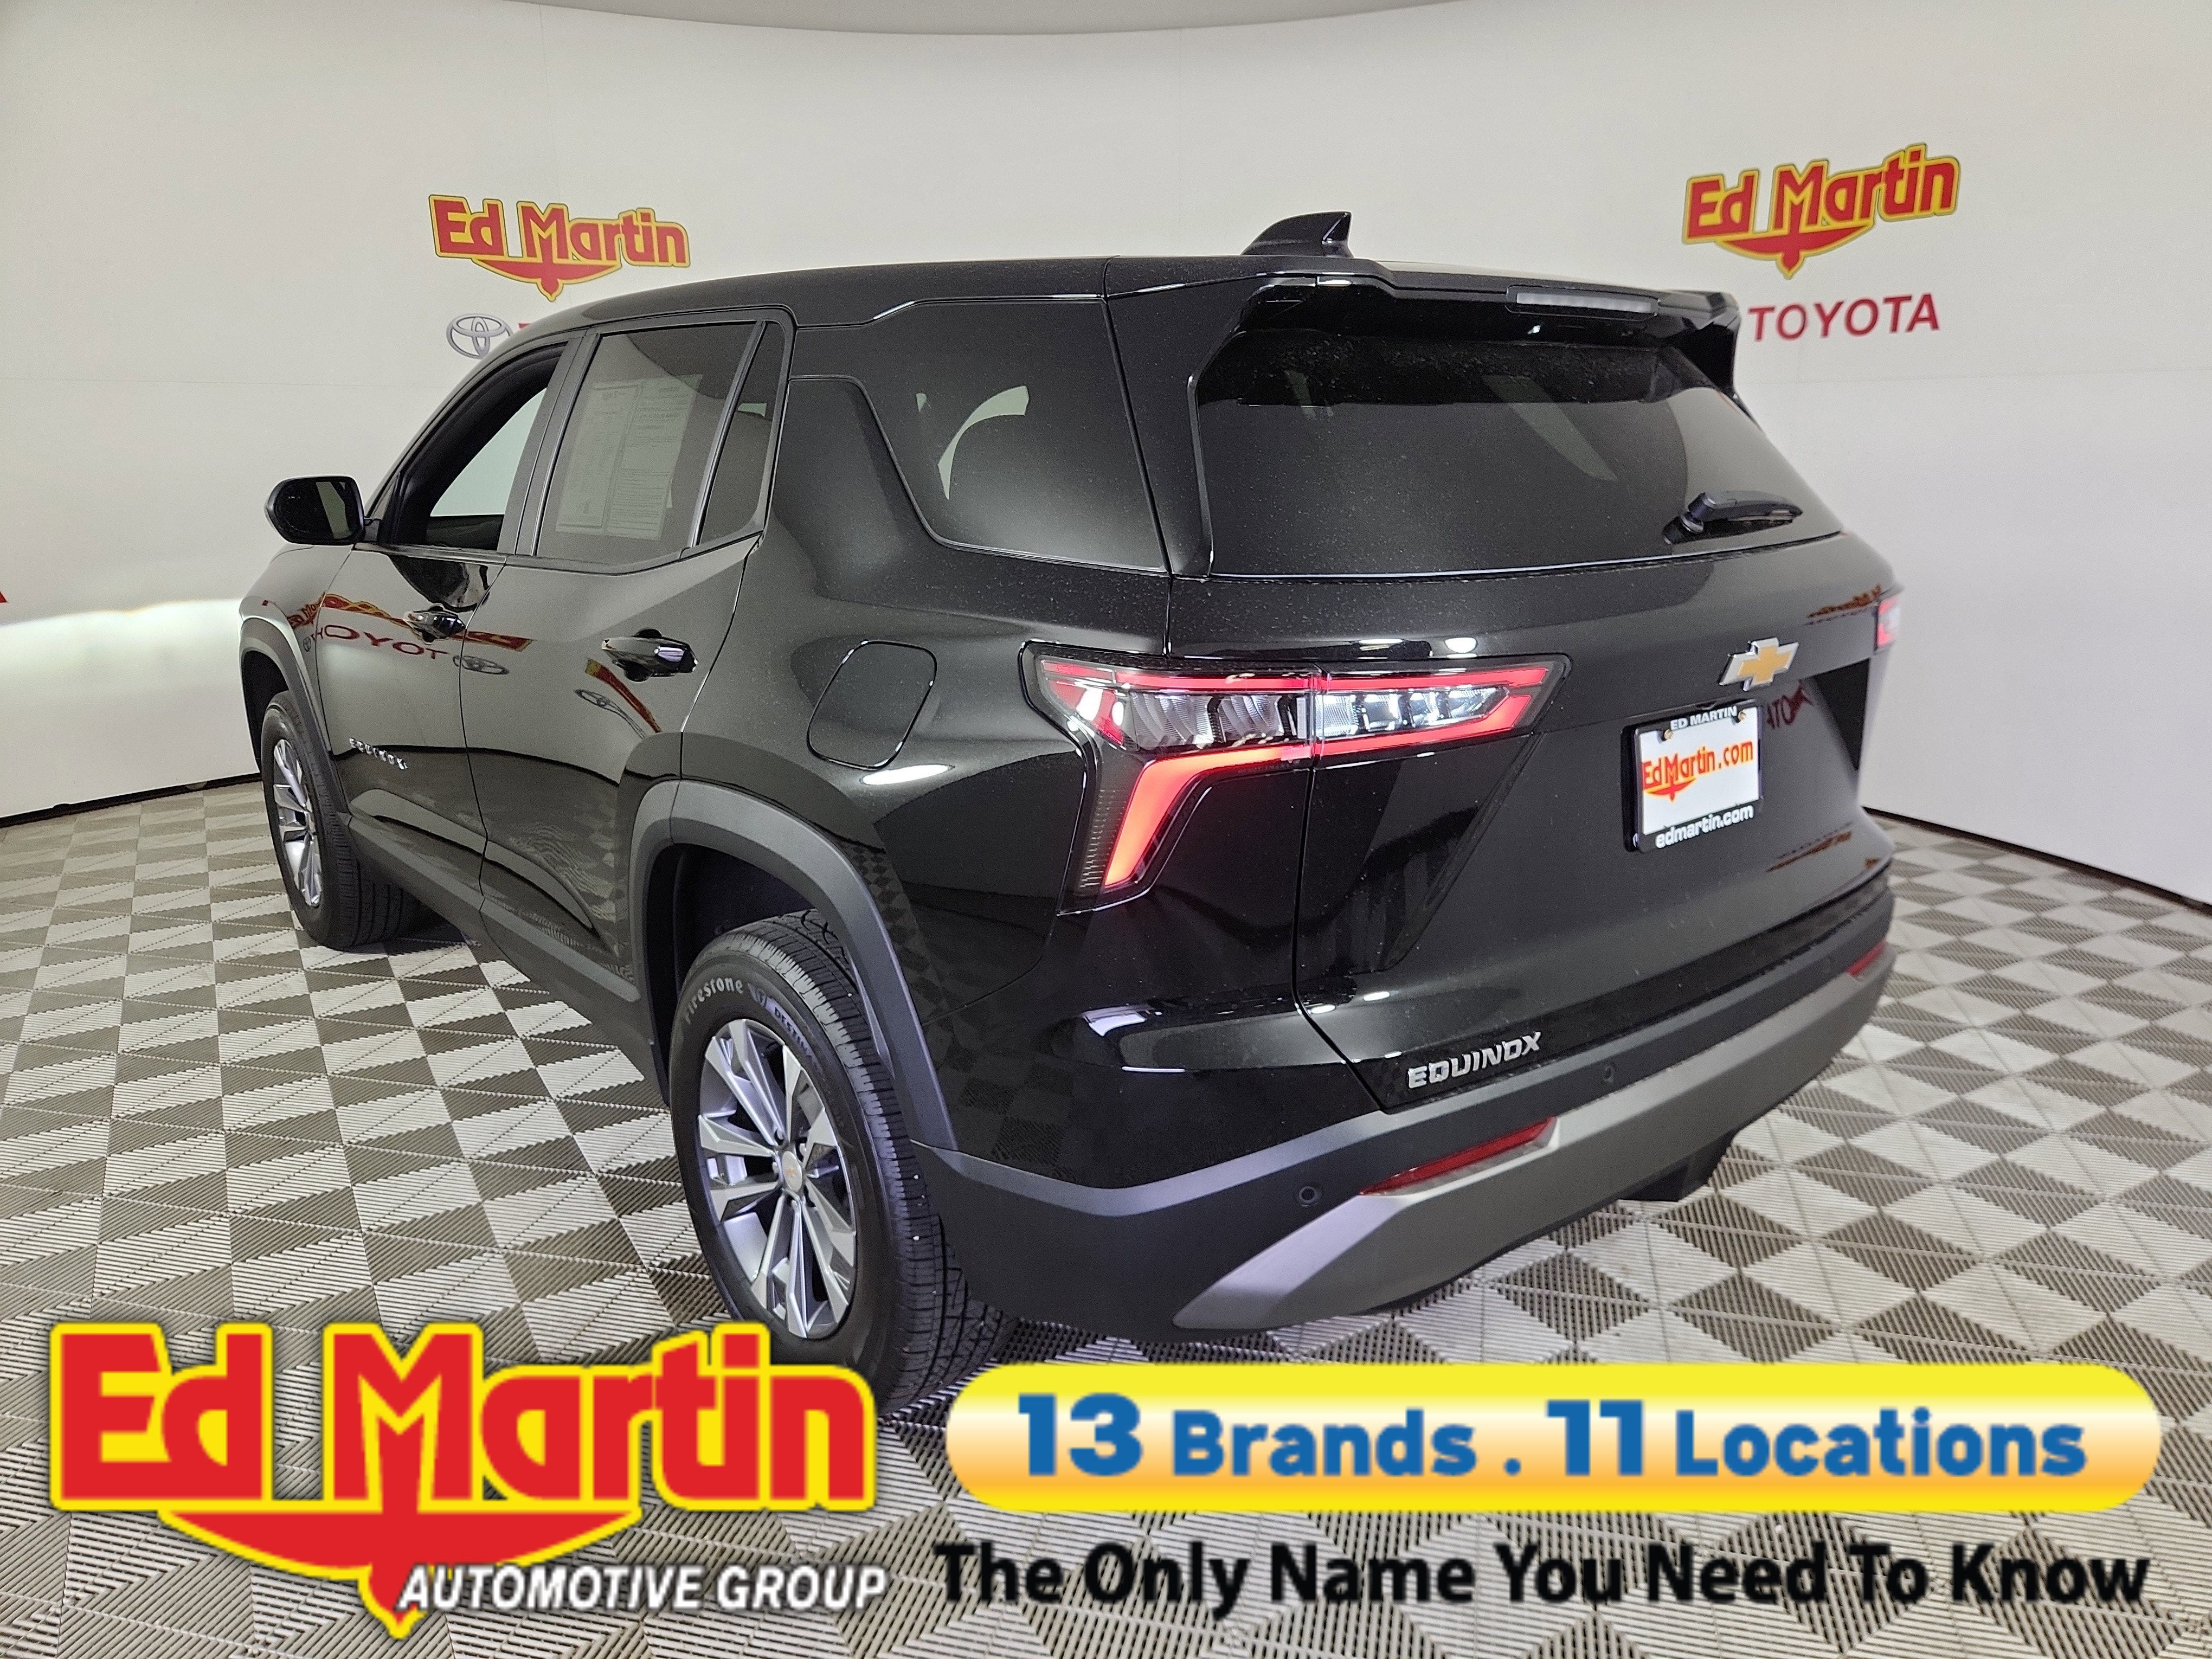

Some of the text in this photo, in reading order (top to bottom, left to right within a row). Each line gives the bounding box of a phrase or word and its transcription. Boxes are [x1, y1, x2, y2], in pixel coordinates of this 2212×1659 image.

[1685, 145, 1958, 241] Ed Martin
[431, 196, 689, 266] Ed Martin
[1748, 293, 1940, 342] TOYOTA
[1670, 705, 1738, 731] ED MARTIN
[1655, 805, 1754, 849] edmartin.com
[1408, 1031, 1542, 1089] EQUINOX
